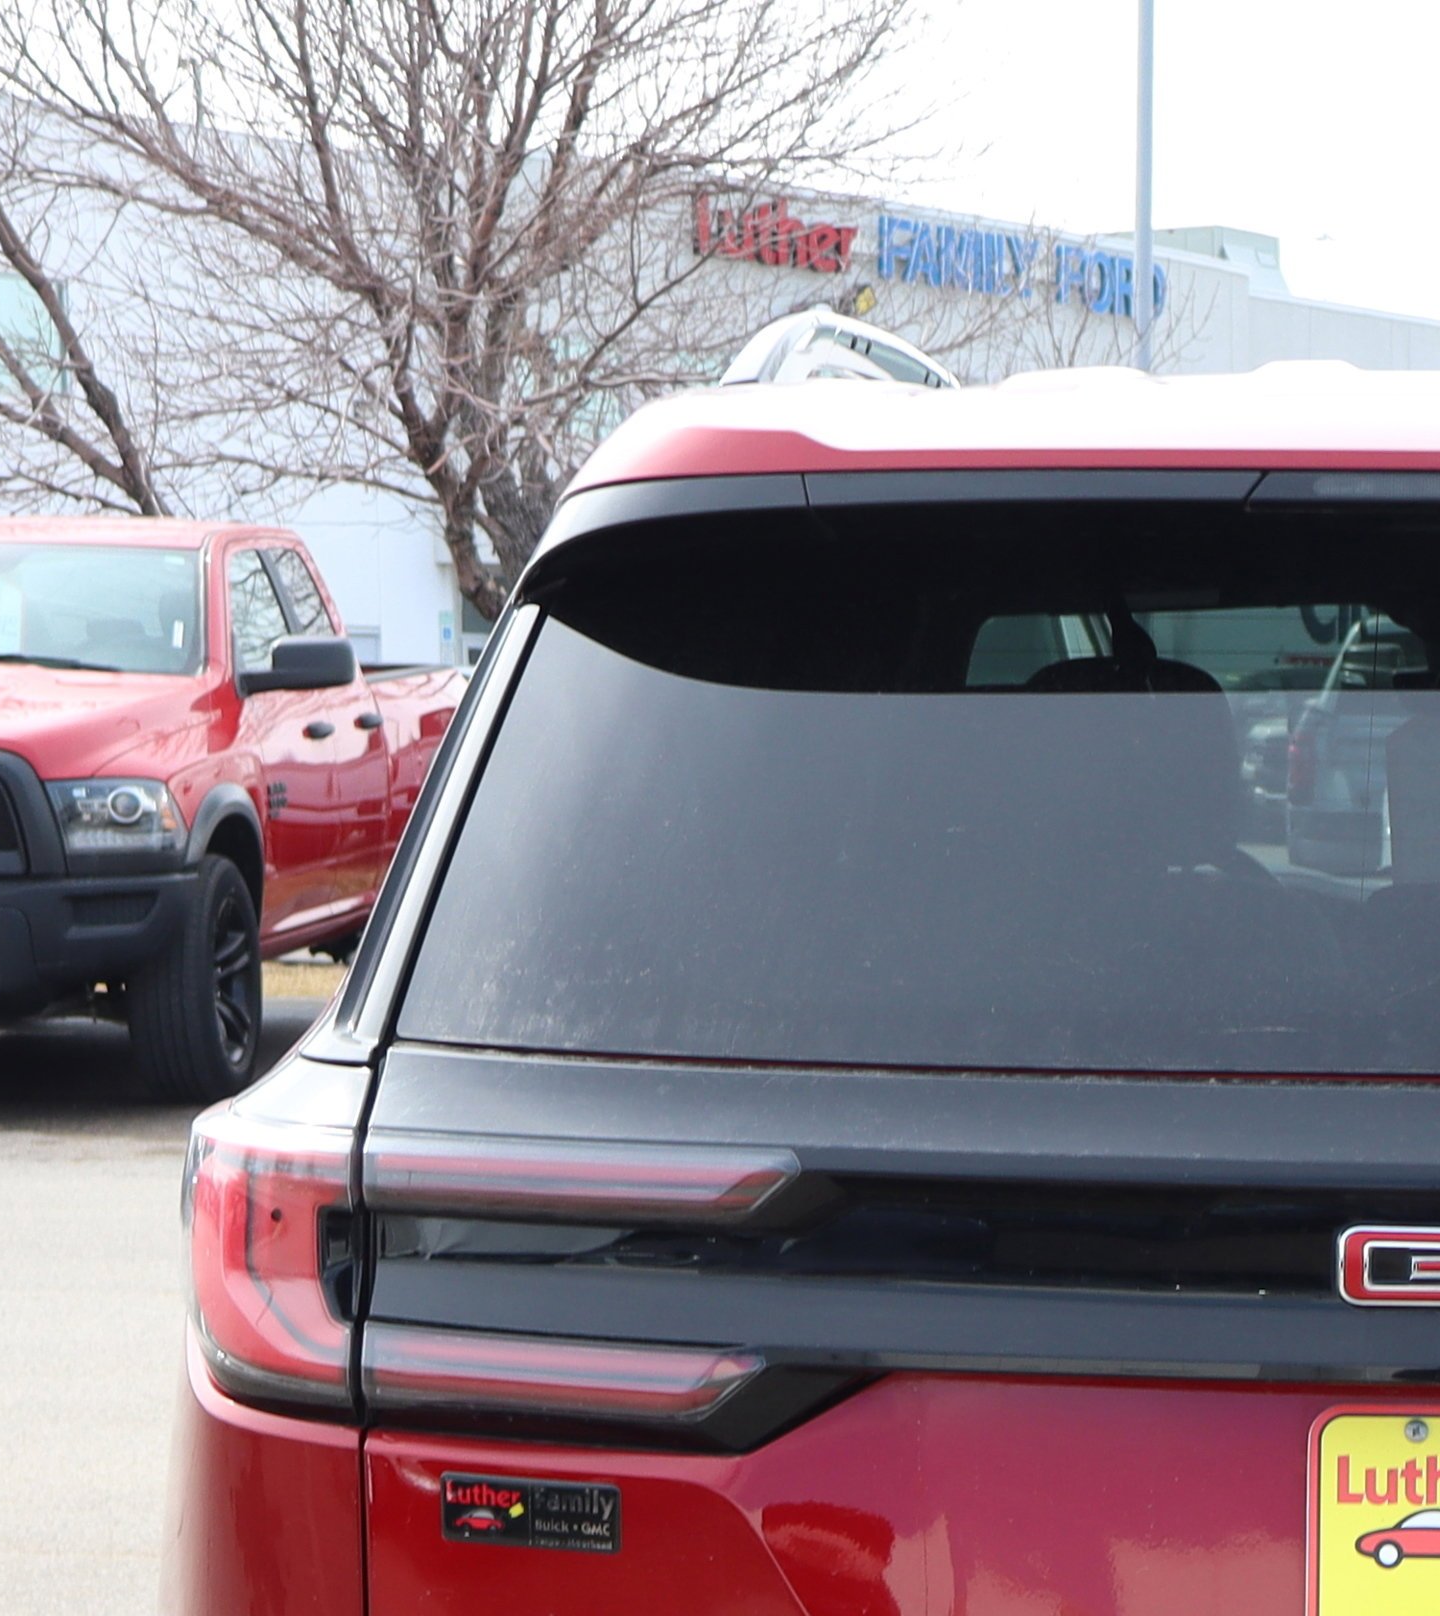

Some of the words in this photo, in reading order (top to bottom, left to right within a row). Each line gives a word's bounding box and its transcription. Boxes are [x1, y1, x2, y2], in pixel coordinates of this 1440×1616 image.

[694, 193, 859, 273] Luther
[878, 214, 1040, 298] FAMILY
[445, 1479, 522, 1508] Luther
[535, 1518, 570, 1533] Buick
[581, 1521, 611, 1537] GMC
